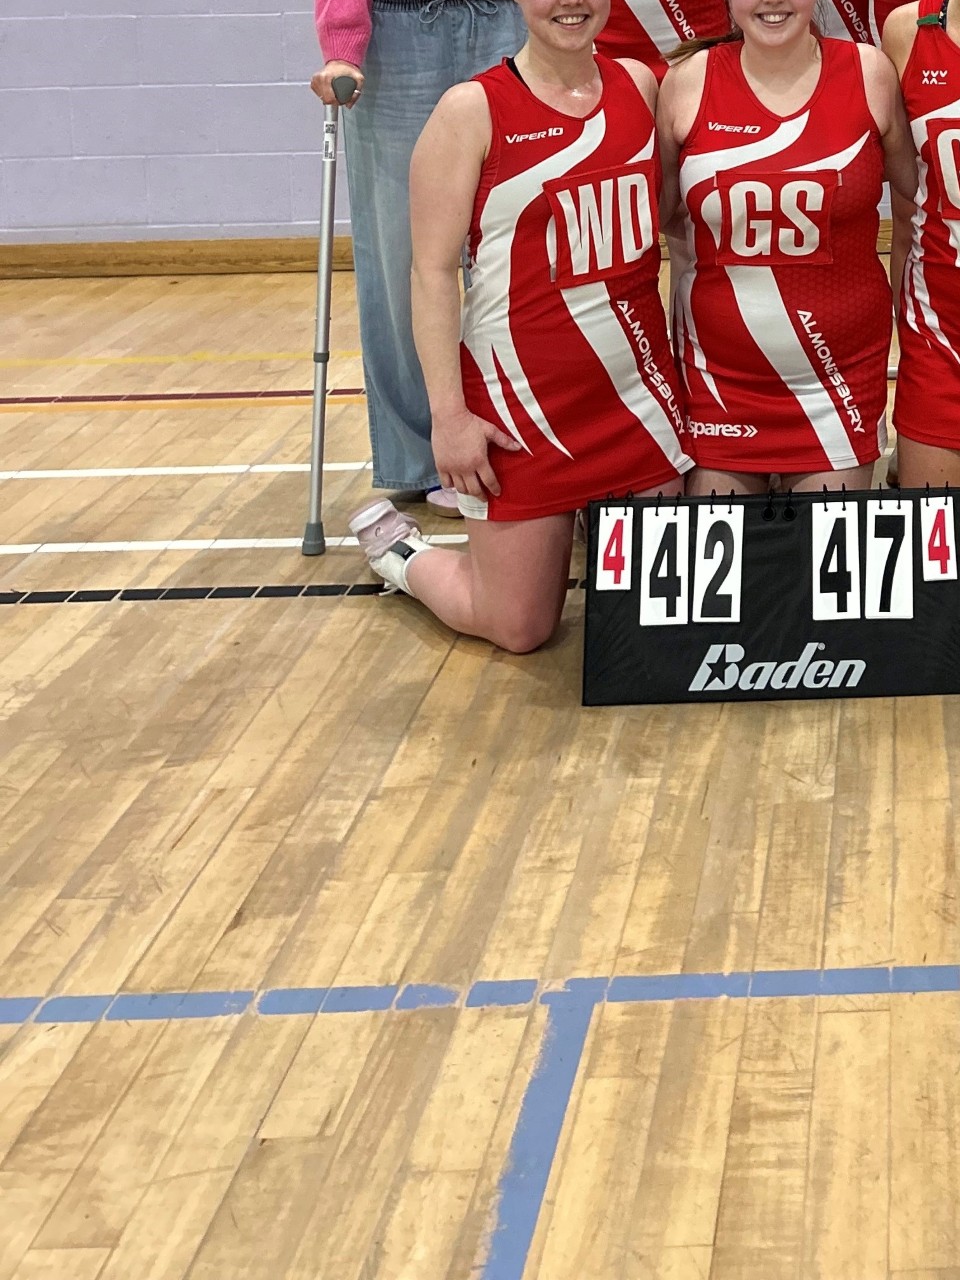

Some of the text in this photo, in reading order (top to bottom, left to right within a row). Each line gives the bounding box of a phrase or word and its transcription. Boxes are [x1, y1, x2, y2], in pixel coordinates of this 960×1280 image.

[555, 173, 655, 276] WD
[728, 180, 825, 257] GS
[602, 519, 625, 585] 4
[928, 508, 951, 574] 4
[688, 642, 867, 691] Baden
